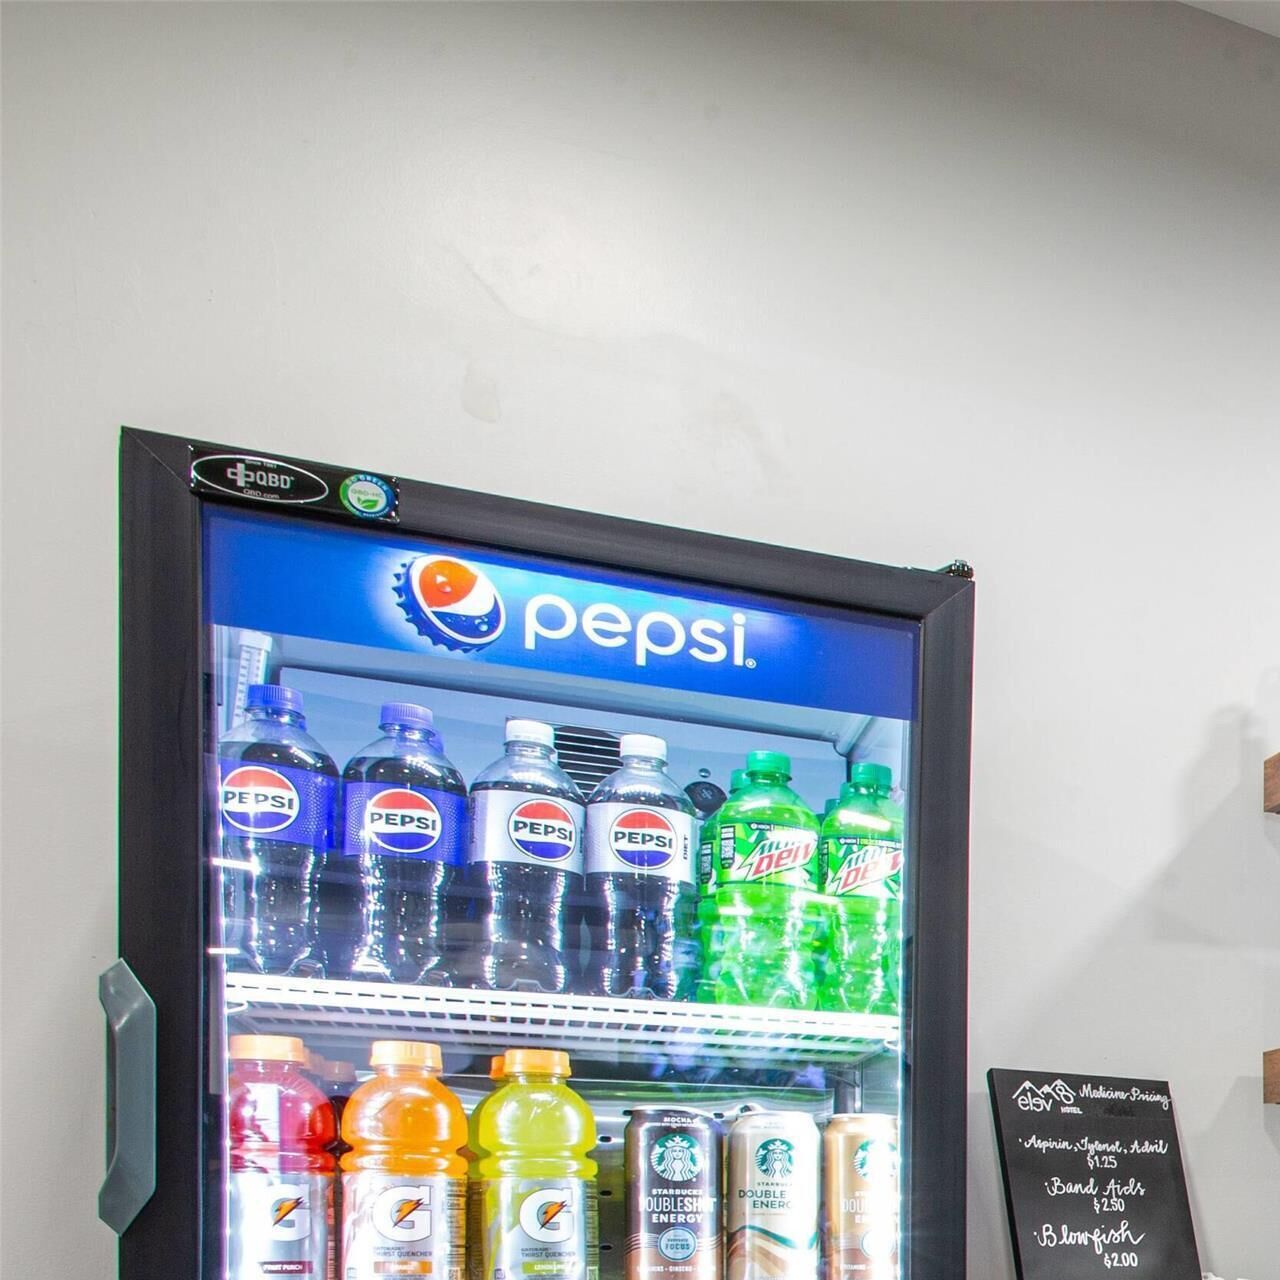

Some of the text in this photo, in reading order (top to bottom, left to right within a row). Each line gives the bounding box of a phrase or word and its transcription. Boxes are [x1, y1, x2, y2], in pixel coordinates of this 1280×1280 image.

[256, 470, 292, 489] QBD
[524, 593, 747, 666] pepsi
[223, 790, 294, 810] PEPSI
[370, 812, 438, 832] PEPSI
[513, 821, 574, 843] PEPSI
[614, 830, 673, 850] PEPSI
[1079, 1083, 1172, 1110] Medicine Pricing
[1061, 1106, 1083, 1114] HOTEL
[663, 1116, 694, 1124] MOCHA
[1129, 1139, 1169, 1154] Advil
[1086, 1153, 1118, 1170] $1.25
[1046, 1177, 1146, 1200] Band Aids
[651, 1213, 704, 1223] ENERGY
[1036, 1220, 1146, 1255] Blowfish
[396, 1250, 433, 1258] QUENCHER
[1103, 1253, 1139, 1269] $2.00
